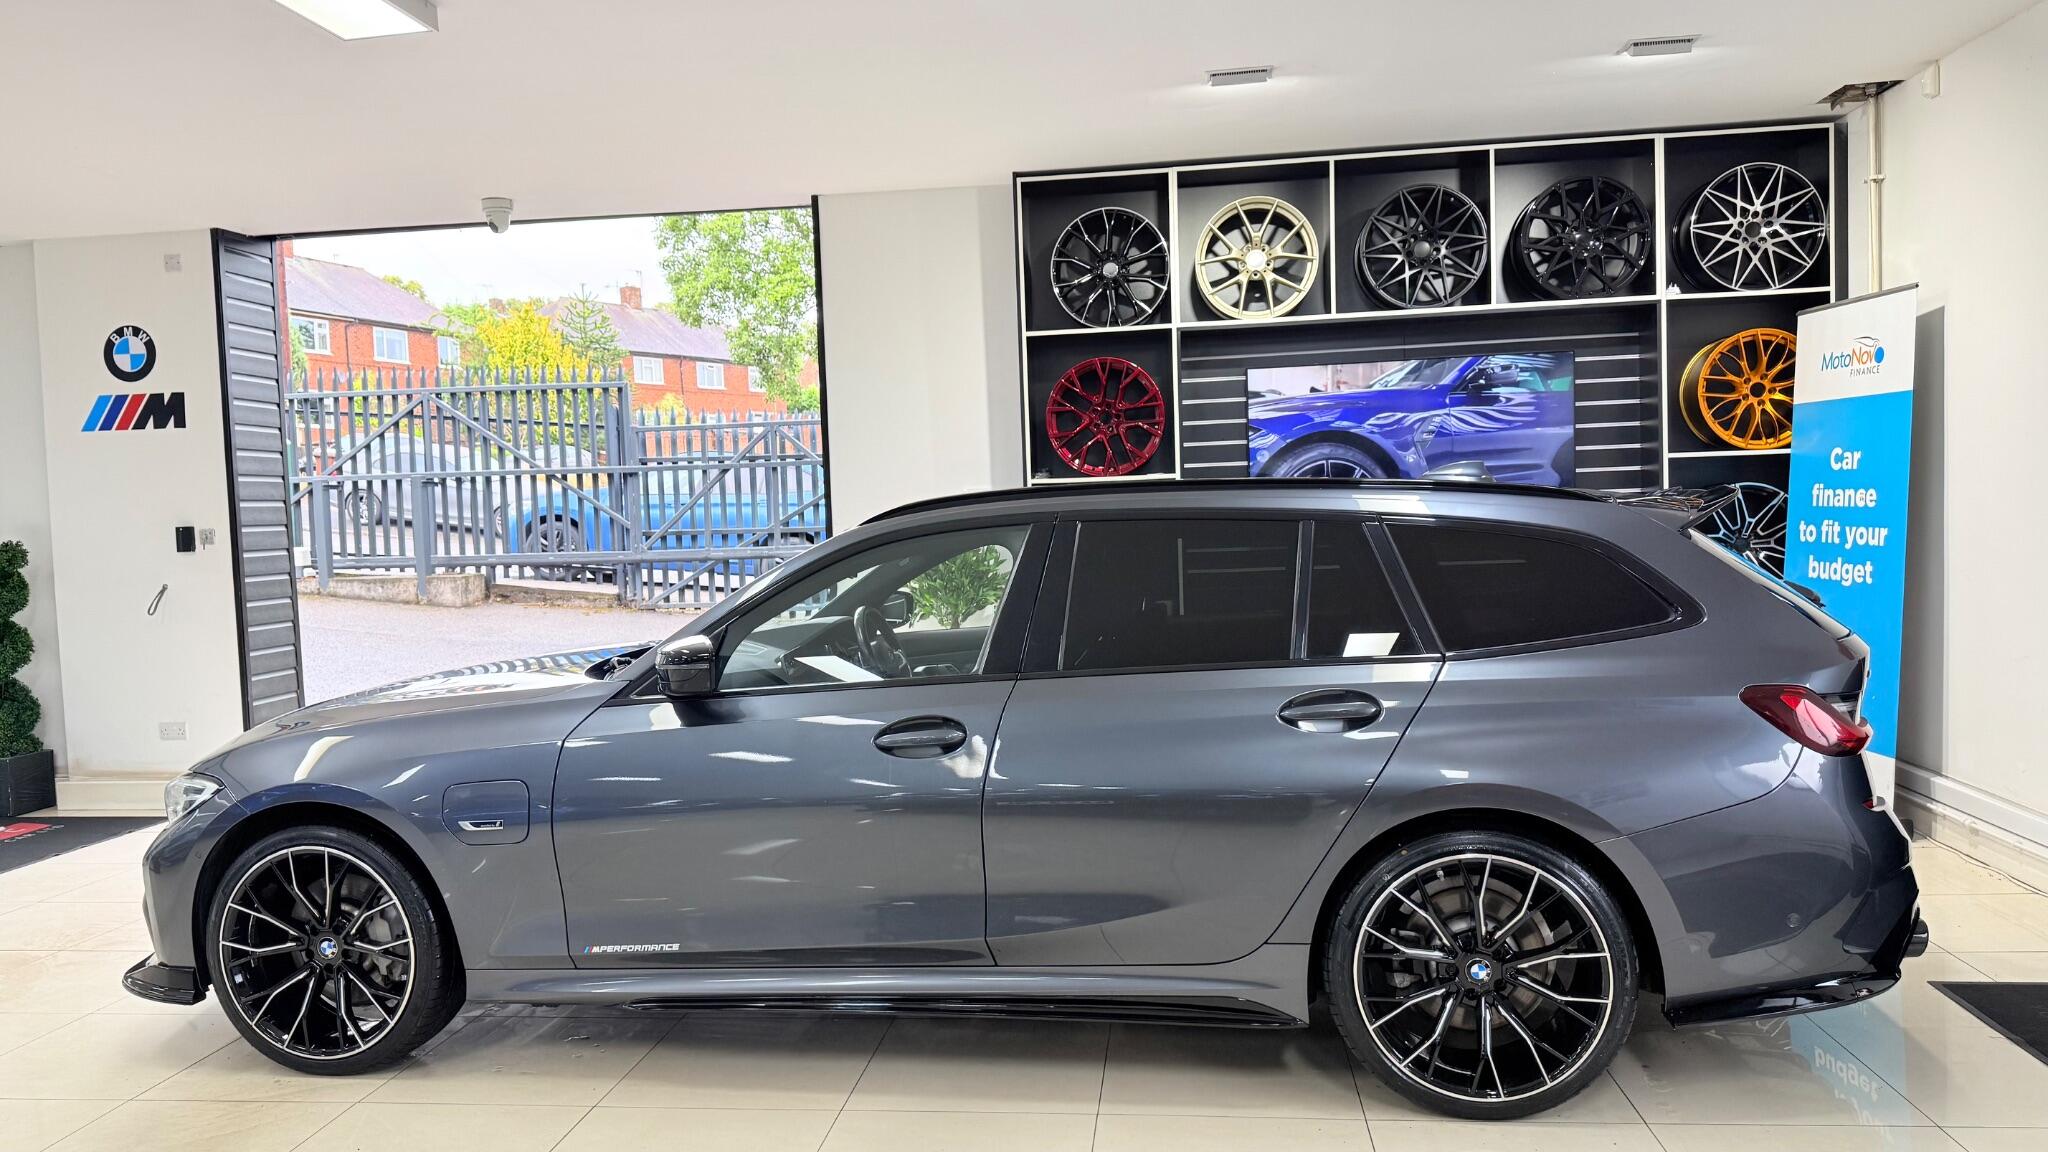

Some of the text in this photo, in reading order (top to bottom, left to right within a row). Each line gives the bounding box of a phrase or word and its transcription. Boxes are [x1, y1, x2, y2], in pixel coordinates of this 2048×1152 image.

[109, 327, 150, 344] BMW
[1849, 365, 1881, 377] FINANCE
[1830, 447, 1862, 471] Car
[1812, 483, 1877, 508] finance
[1799, 519, 1888, 550] to fit your
[1808, 554, 1873, 587] budget
